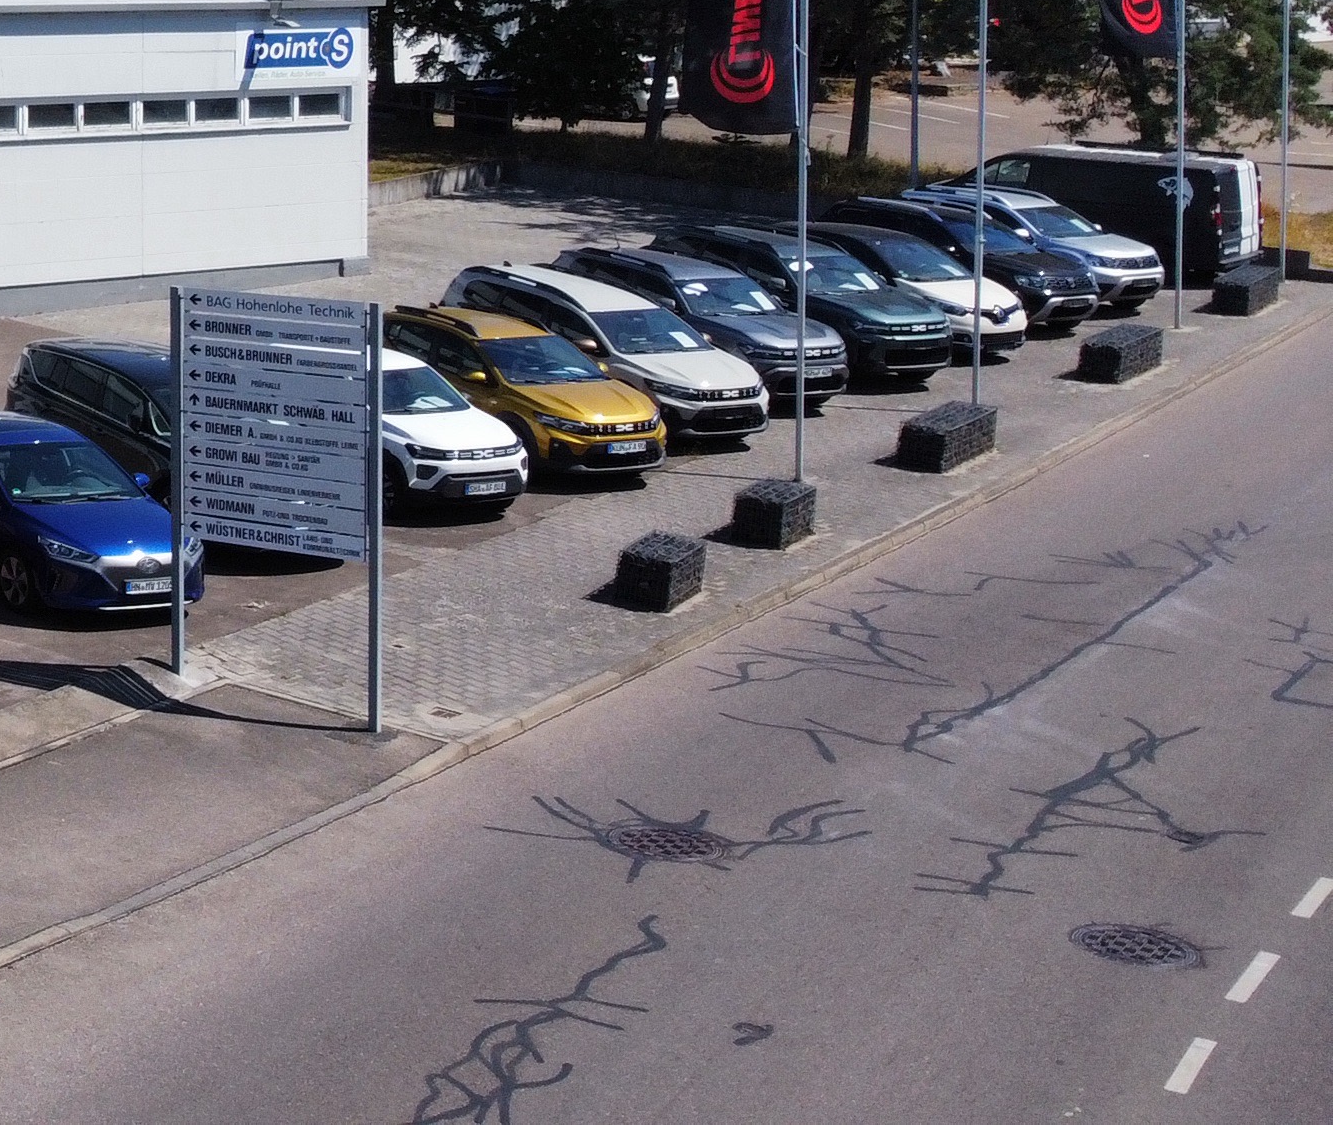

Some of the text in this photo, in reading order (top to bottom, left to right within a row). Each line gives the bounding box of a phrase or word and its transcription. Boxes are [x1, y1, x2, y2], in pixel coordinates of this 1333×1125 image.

[253, 34, 349, 64] point S
[206, 295, 355, 320] BAG Hohenlohe Technik
[204, 320, 252, 337] BRONNER
[204, 345, 293, 366] BUSCH&BRUNNER
[204, 370, 237, 386] DEKRA
[204, 395, 356, 425] BAUERNMARKT SCHWÄB. HALL
[204, 421, 243, 437] DIEMER
[247, 427, 258, 439] A.
[205, 446, 261, 466] GROWI BAU
[205, 470, 244, 489] MÜLLER
[206, 497, 256, 516] WIDMANN
[205, 521, 301, 547] WÜSTNER&CHRIST
